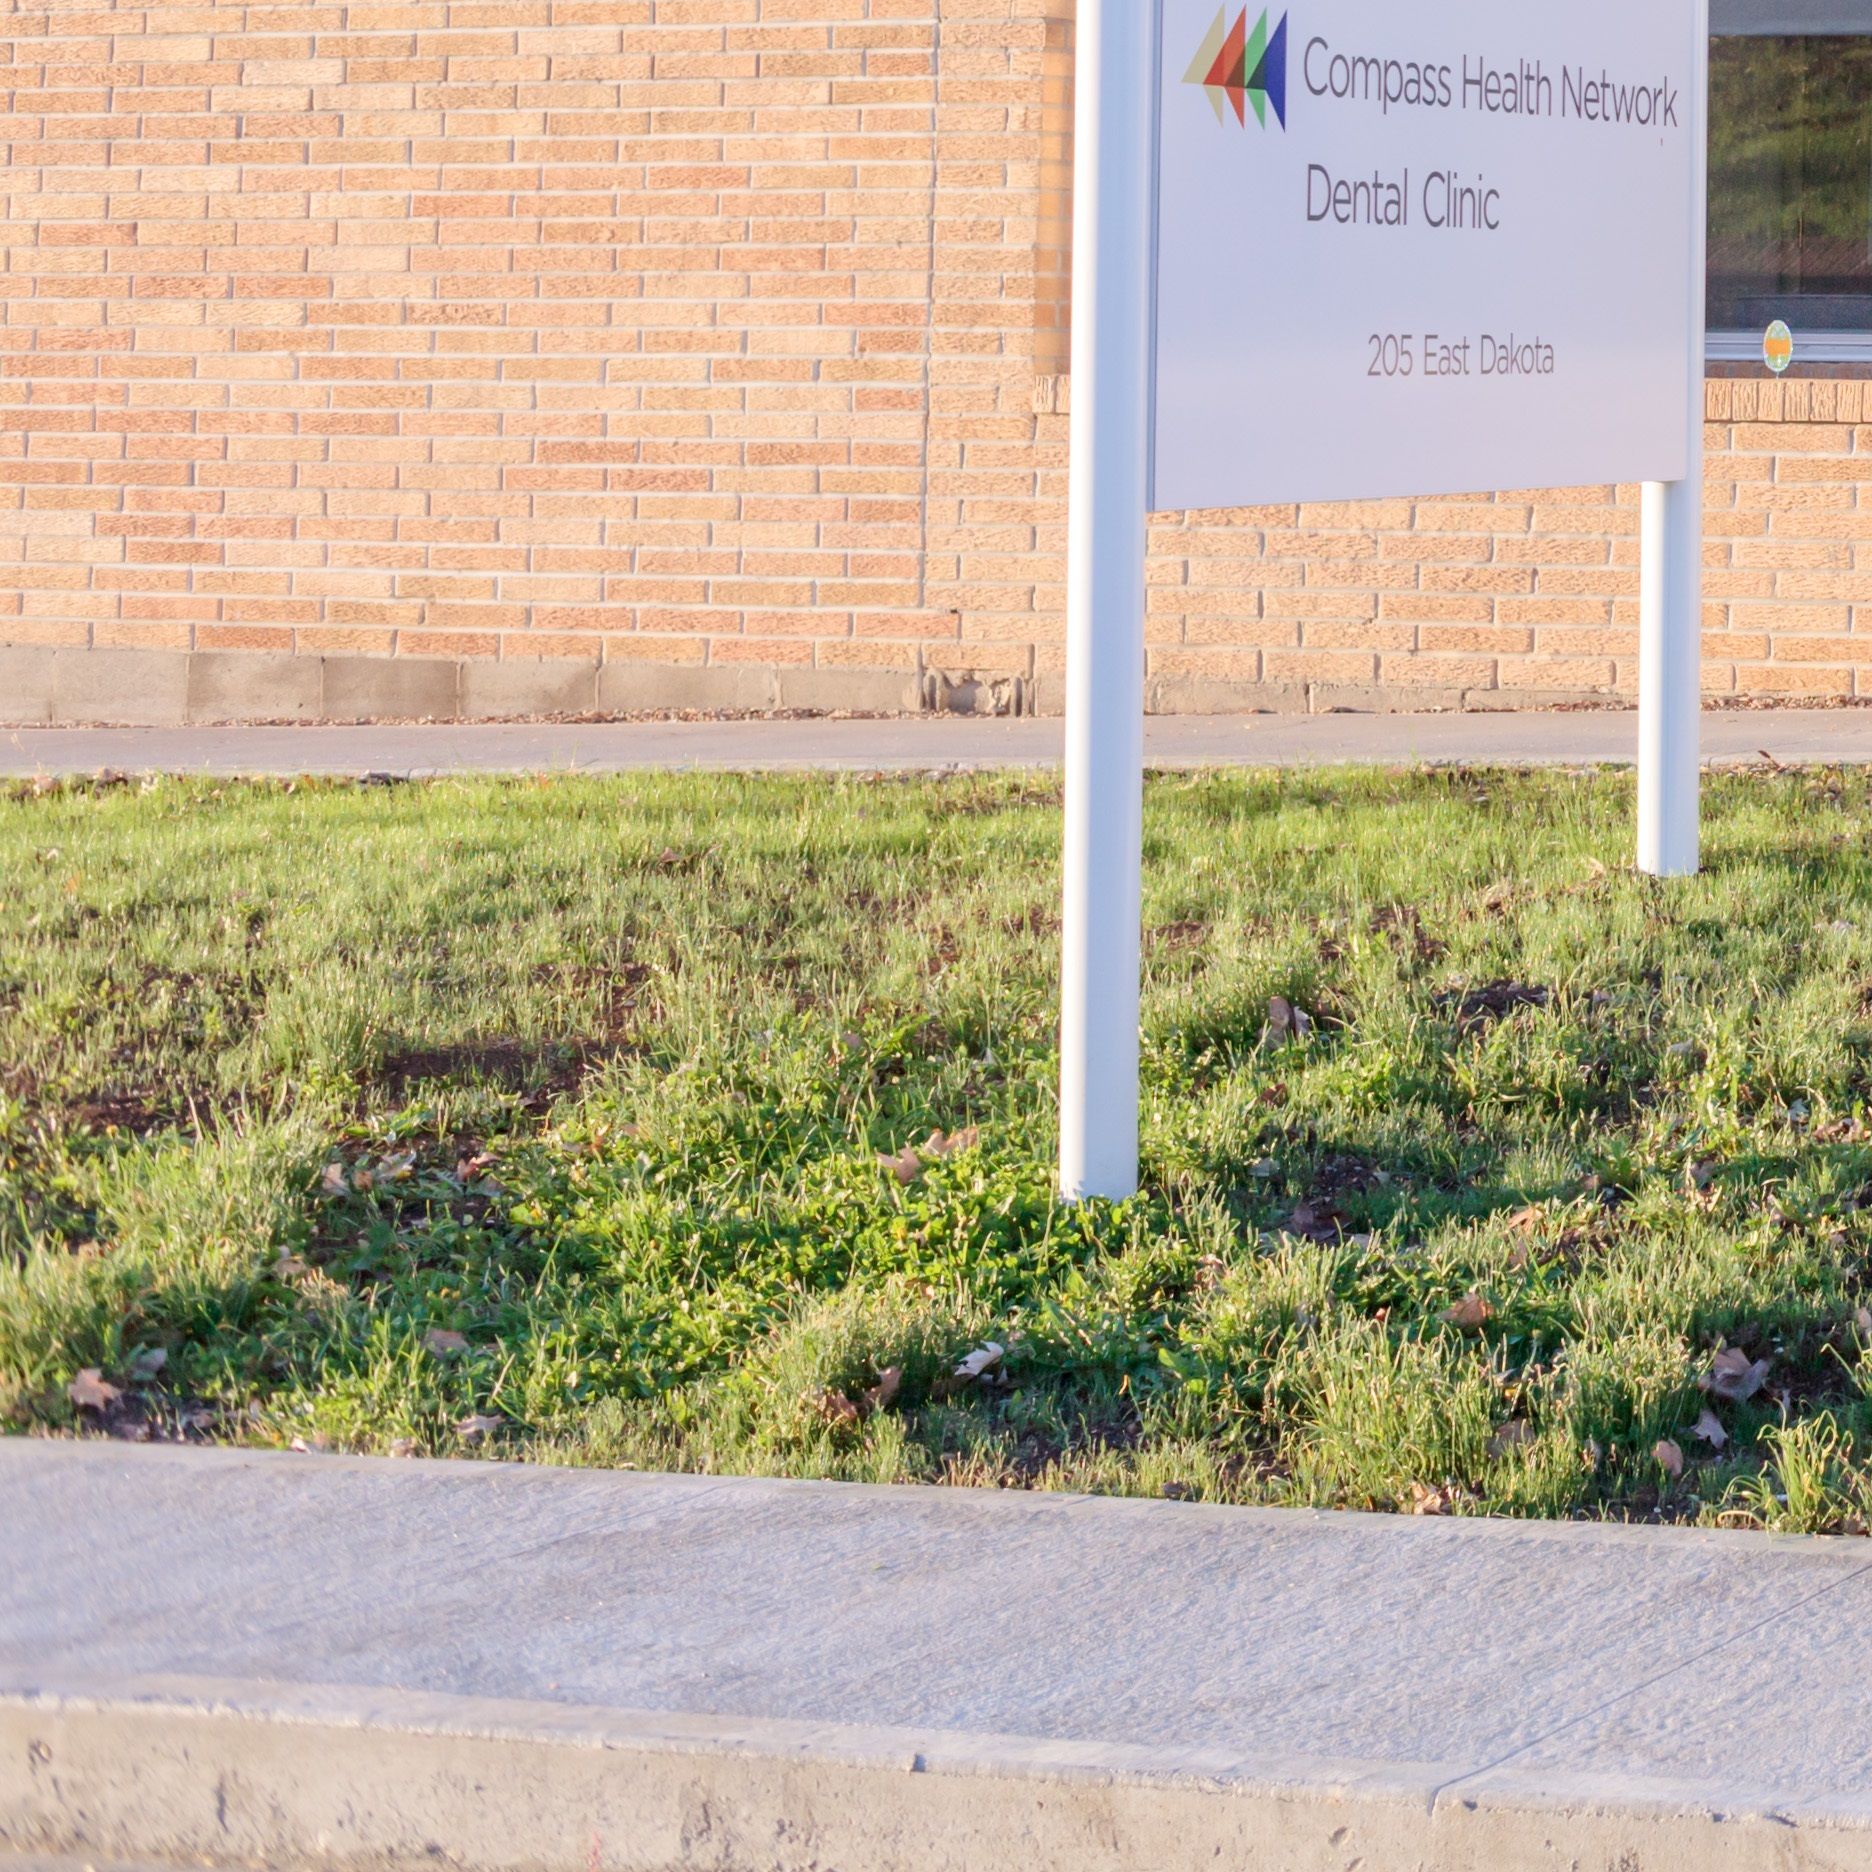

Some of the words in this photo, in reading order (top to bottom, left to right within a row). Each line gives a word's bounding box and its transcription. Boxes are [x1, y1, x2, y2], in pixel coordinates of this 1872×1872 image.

[1303, 36, 1452, 116] Compass
[1462, 53, 1552, 117] Health
[1561, 64, 1678, 128] Network
[1306, 163, 1409, 226] Dental
[1422, 170, 1500, 231] Clinic
[1367, 333, 1413, 377] 205
[1423, 333, 1471, 376] East
[1480, 333, 1554, 375] Dakota
